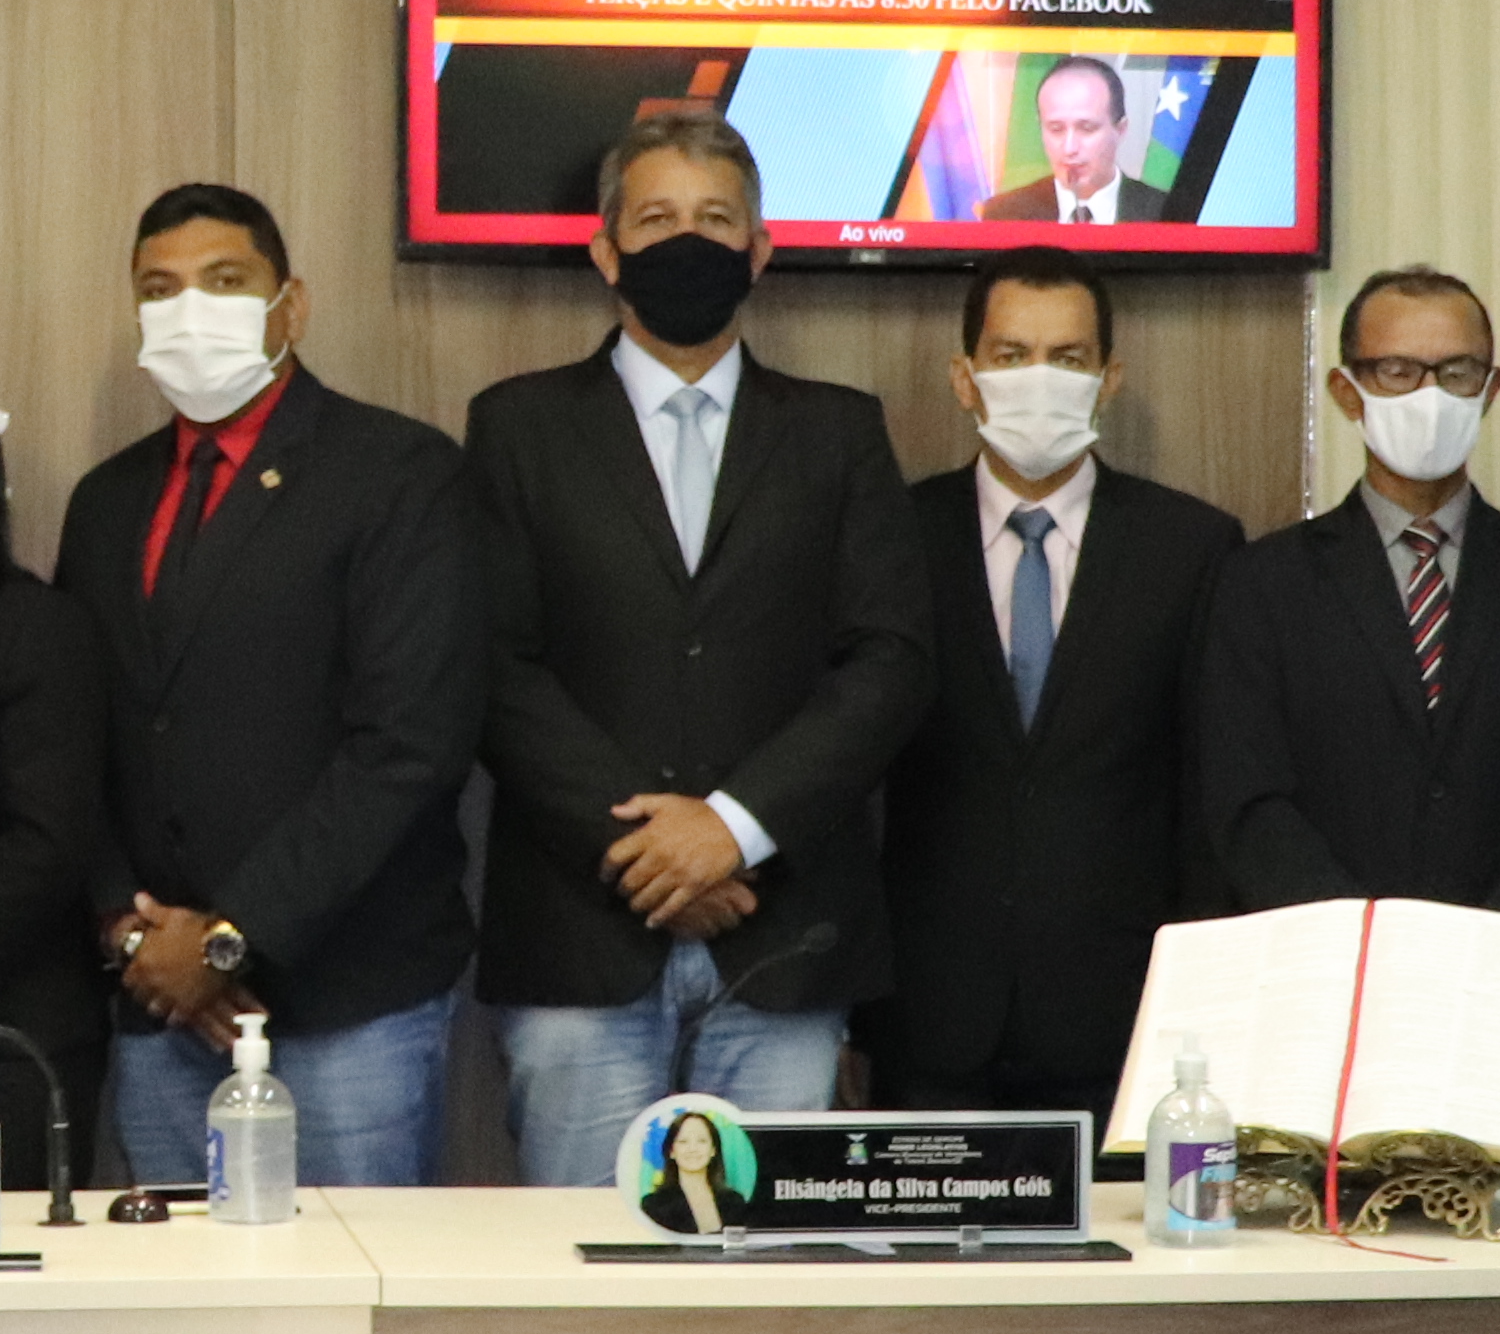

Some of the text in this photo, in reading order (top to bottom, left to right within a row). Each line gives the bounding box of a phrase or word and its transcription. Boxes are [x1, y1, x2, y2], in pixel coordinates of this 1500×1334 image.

[838, 224, 906, 243] Ao vivo
[774, 1175, 1052, 1202] Elisângela da Silva Campos Góis
[864, 1202, 963, 1215] VICE-PRESIDENTE
